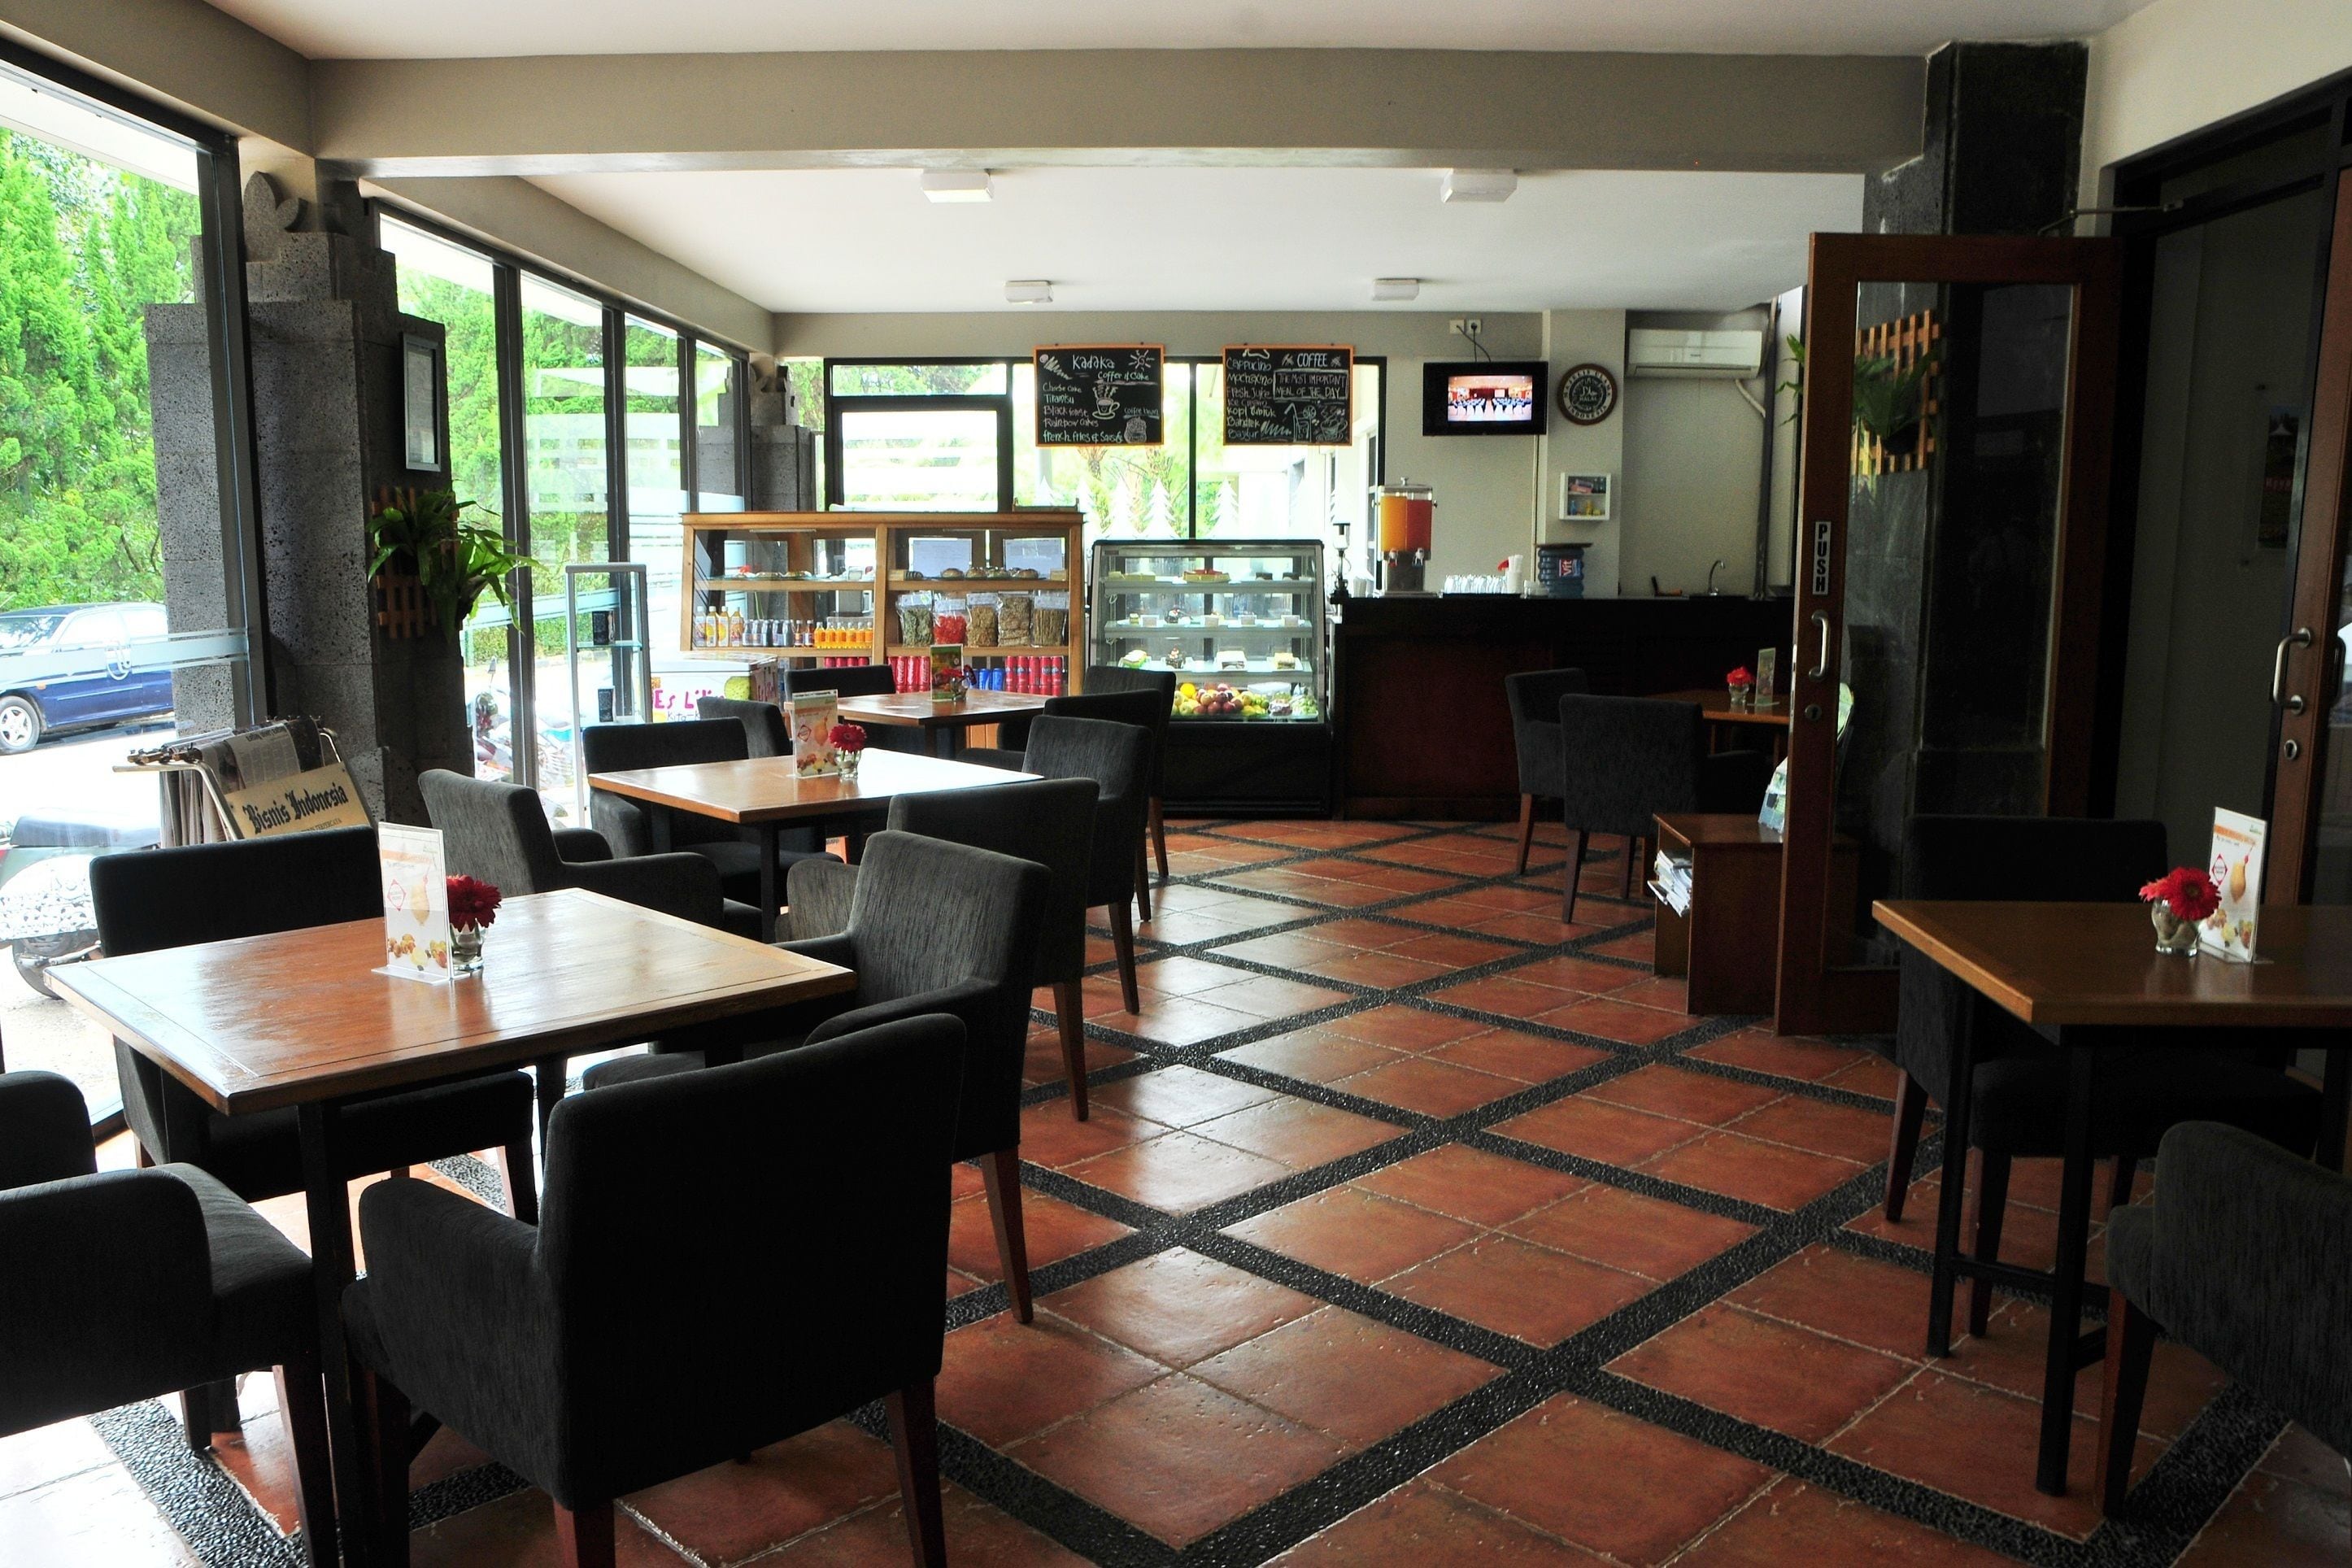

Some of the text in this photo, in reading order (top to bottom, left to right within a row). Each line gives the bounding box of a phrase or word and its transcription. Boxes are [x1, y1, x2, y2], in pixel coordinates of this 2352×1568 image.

[1073, 355, 1115, 369] Kadaka
[1297, 352, 1328, 368] COFFEE
[1097, 371, 1122, 381] Coffee
[1291, 373, 1307, 384] MOST
[1309, 373, 1346, 388] IMPORTANT
[1296, 386, 1306, 396] OF
[1325, 386, 1340, 399] DAY
[1043, 405, 1067, 416] Black
[1815, 523, 1828, 592] PUSH
[655, 690, 676, 709] Es
[242, 782, 349, 834] Bisnis Indonesia
